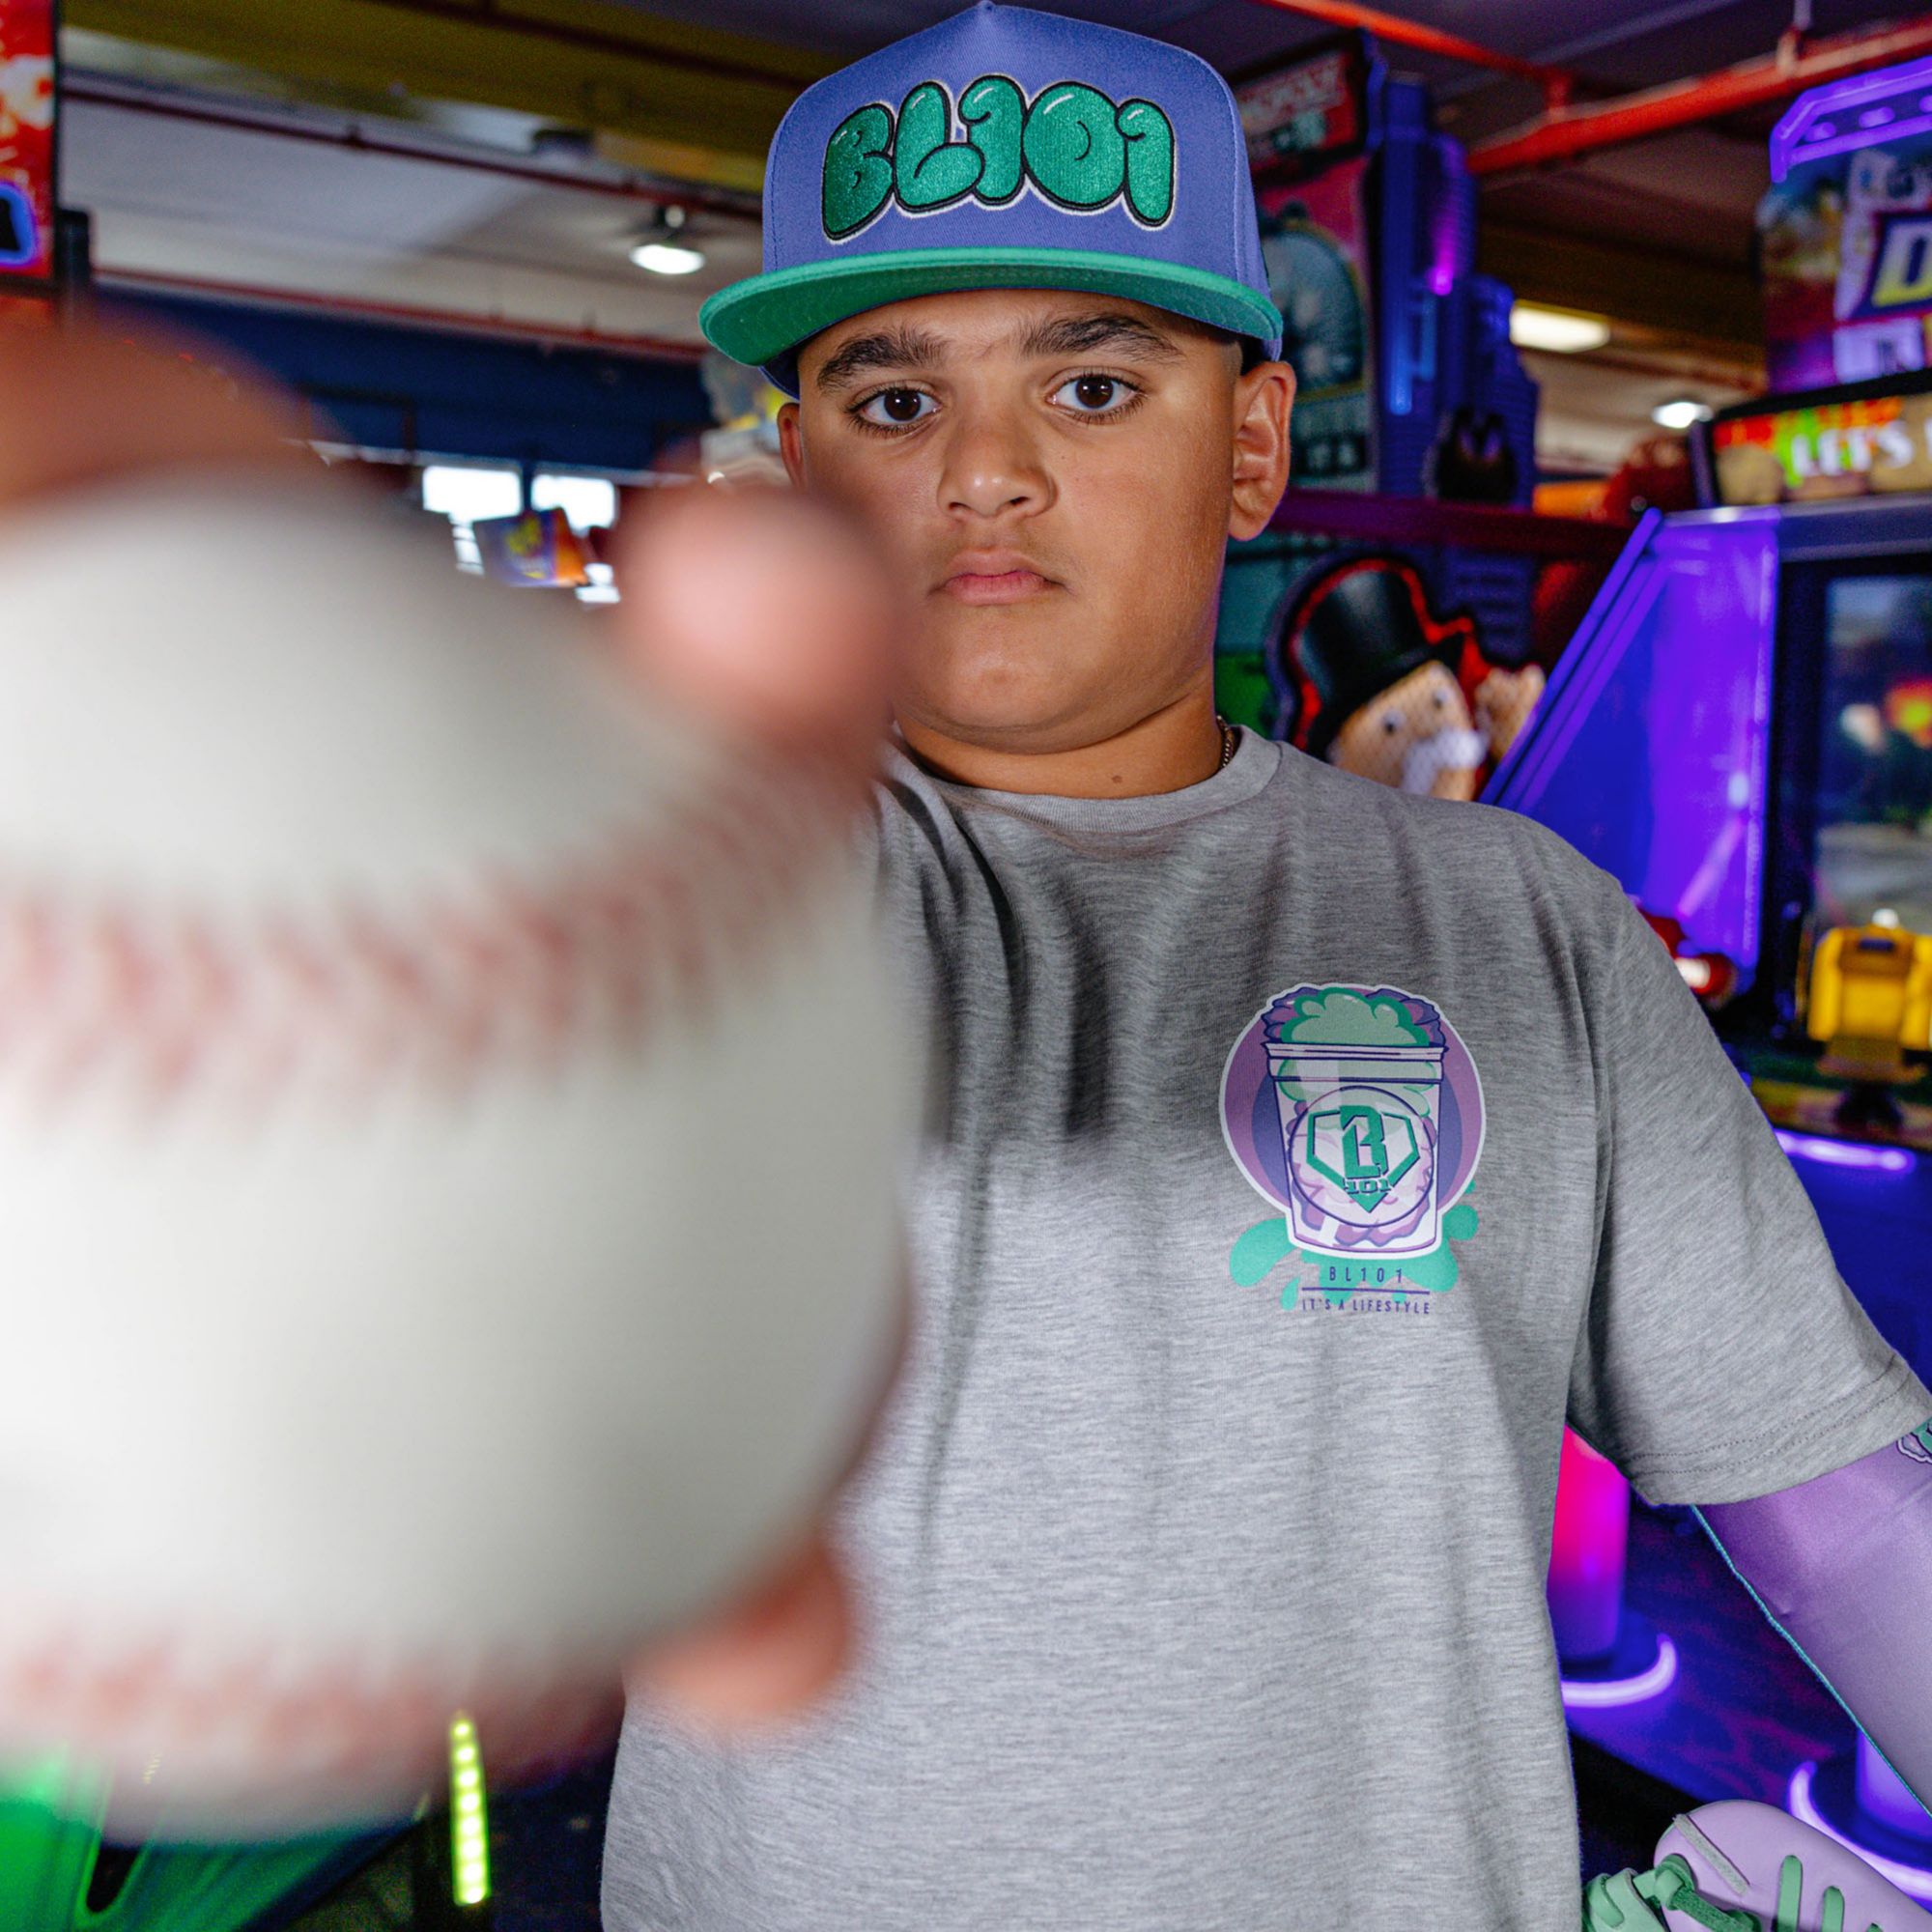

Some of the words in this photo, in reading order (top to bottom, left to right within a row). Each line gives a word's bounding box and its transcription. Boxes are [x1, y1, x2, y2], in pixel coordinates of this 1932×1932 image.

[822, 72, 1174, 243] BL101
[1328, 1266, 1403, 1283] BL101
[1302, 1299, 1331, 1311] IT'S
[1338, 1299, 1345, 1310] A
[1352, 1299, 1431, 1315] LIFESTYLE
